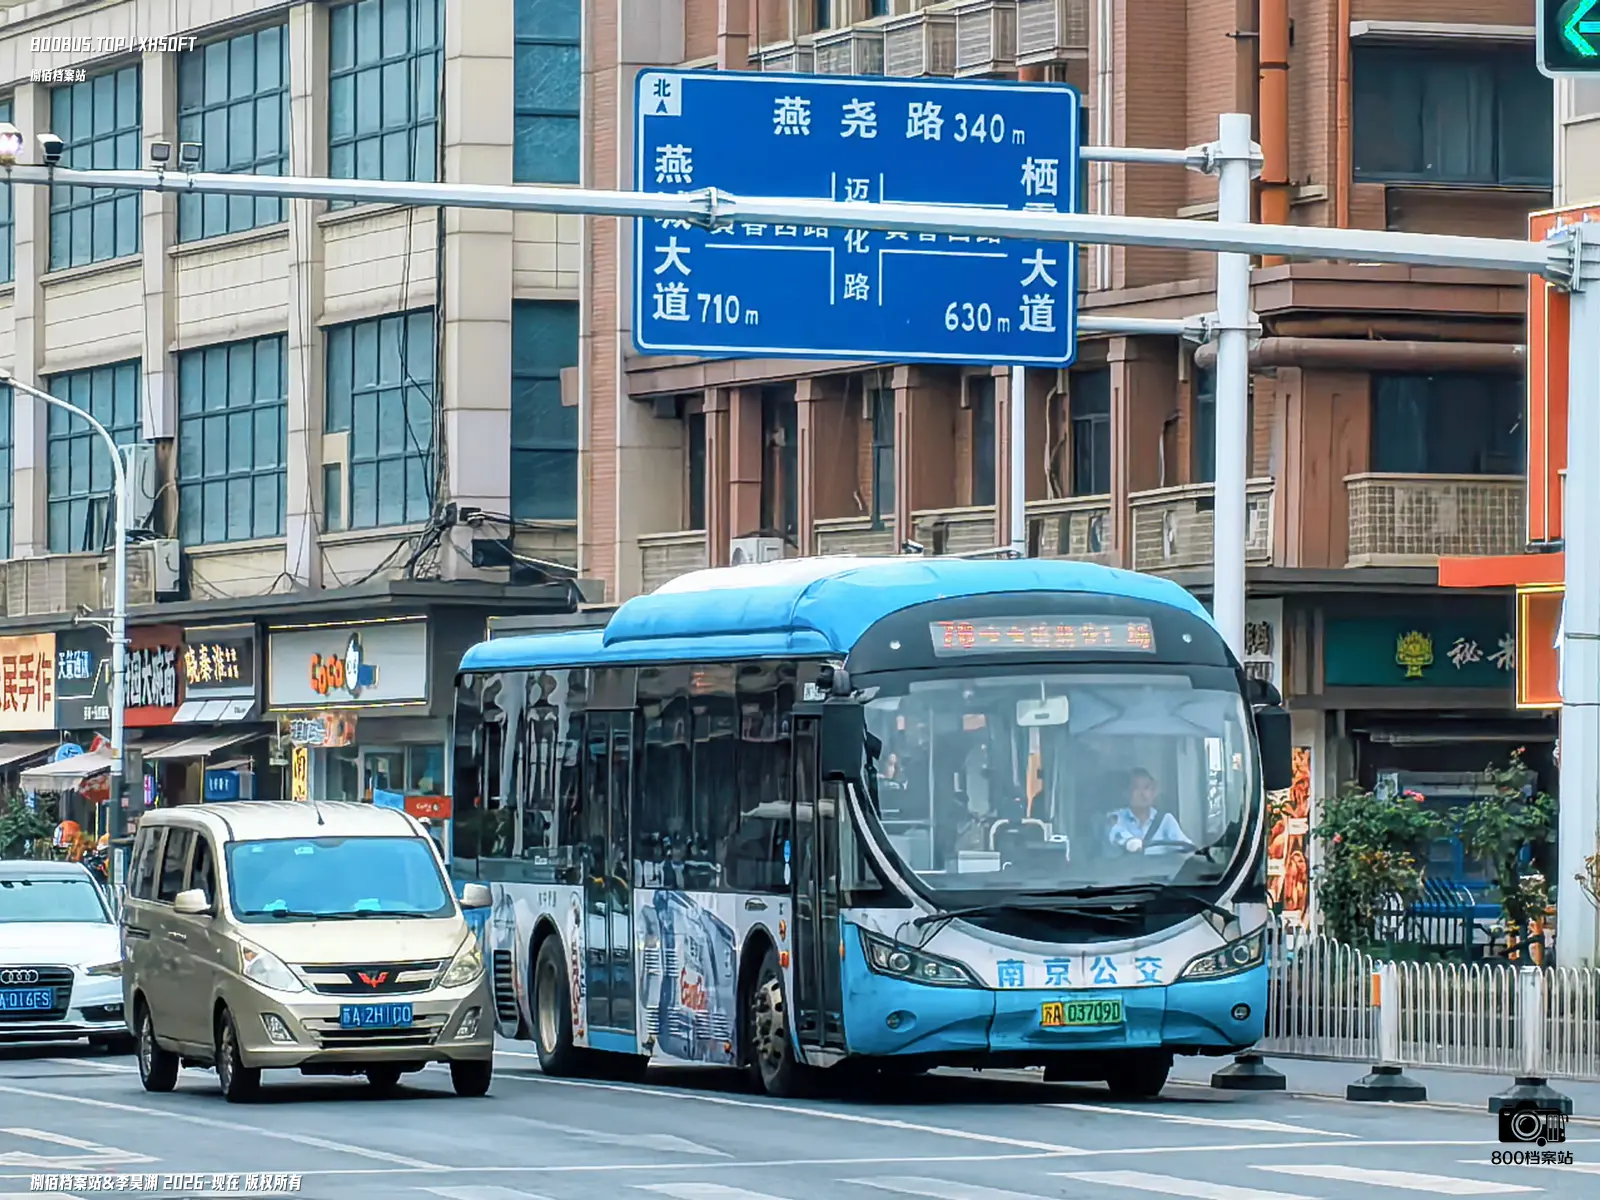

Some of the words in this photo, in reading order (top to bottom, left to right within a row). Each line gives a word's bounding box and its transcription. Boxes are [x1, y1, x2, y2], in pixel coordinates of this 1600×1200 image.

[653, 79, 671, 97] 北
[773, 96, 945, 142] 燕尧路
[652, 143, 693, 322] 燕大道
[996, 956, 1163, 988] 南京公交
